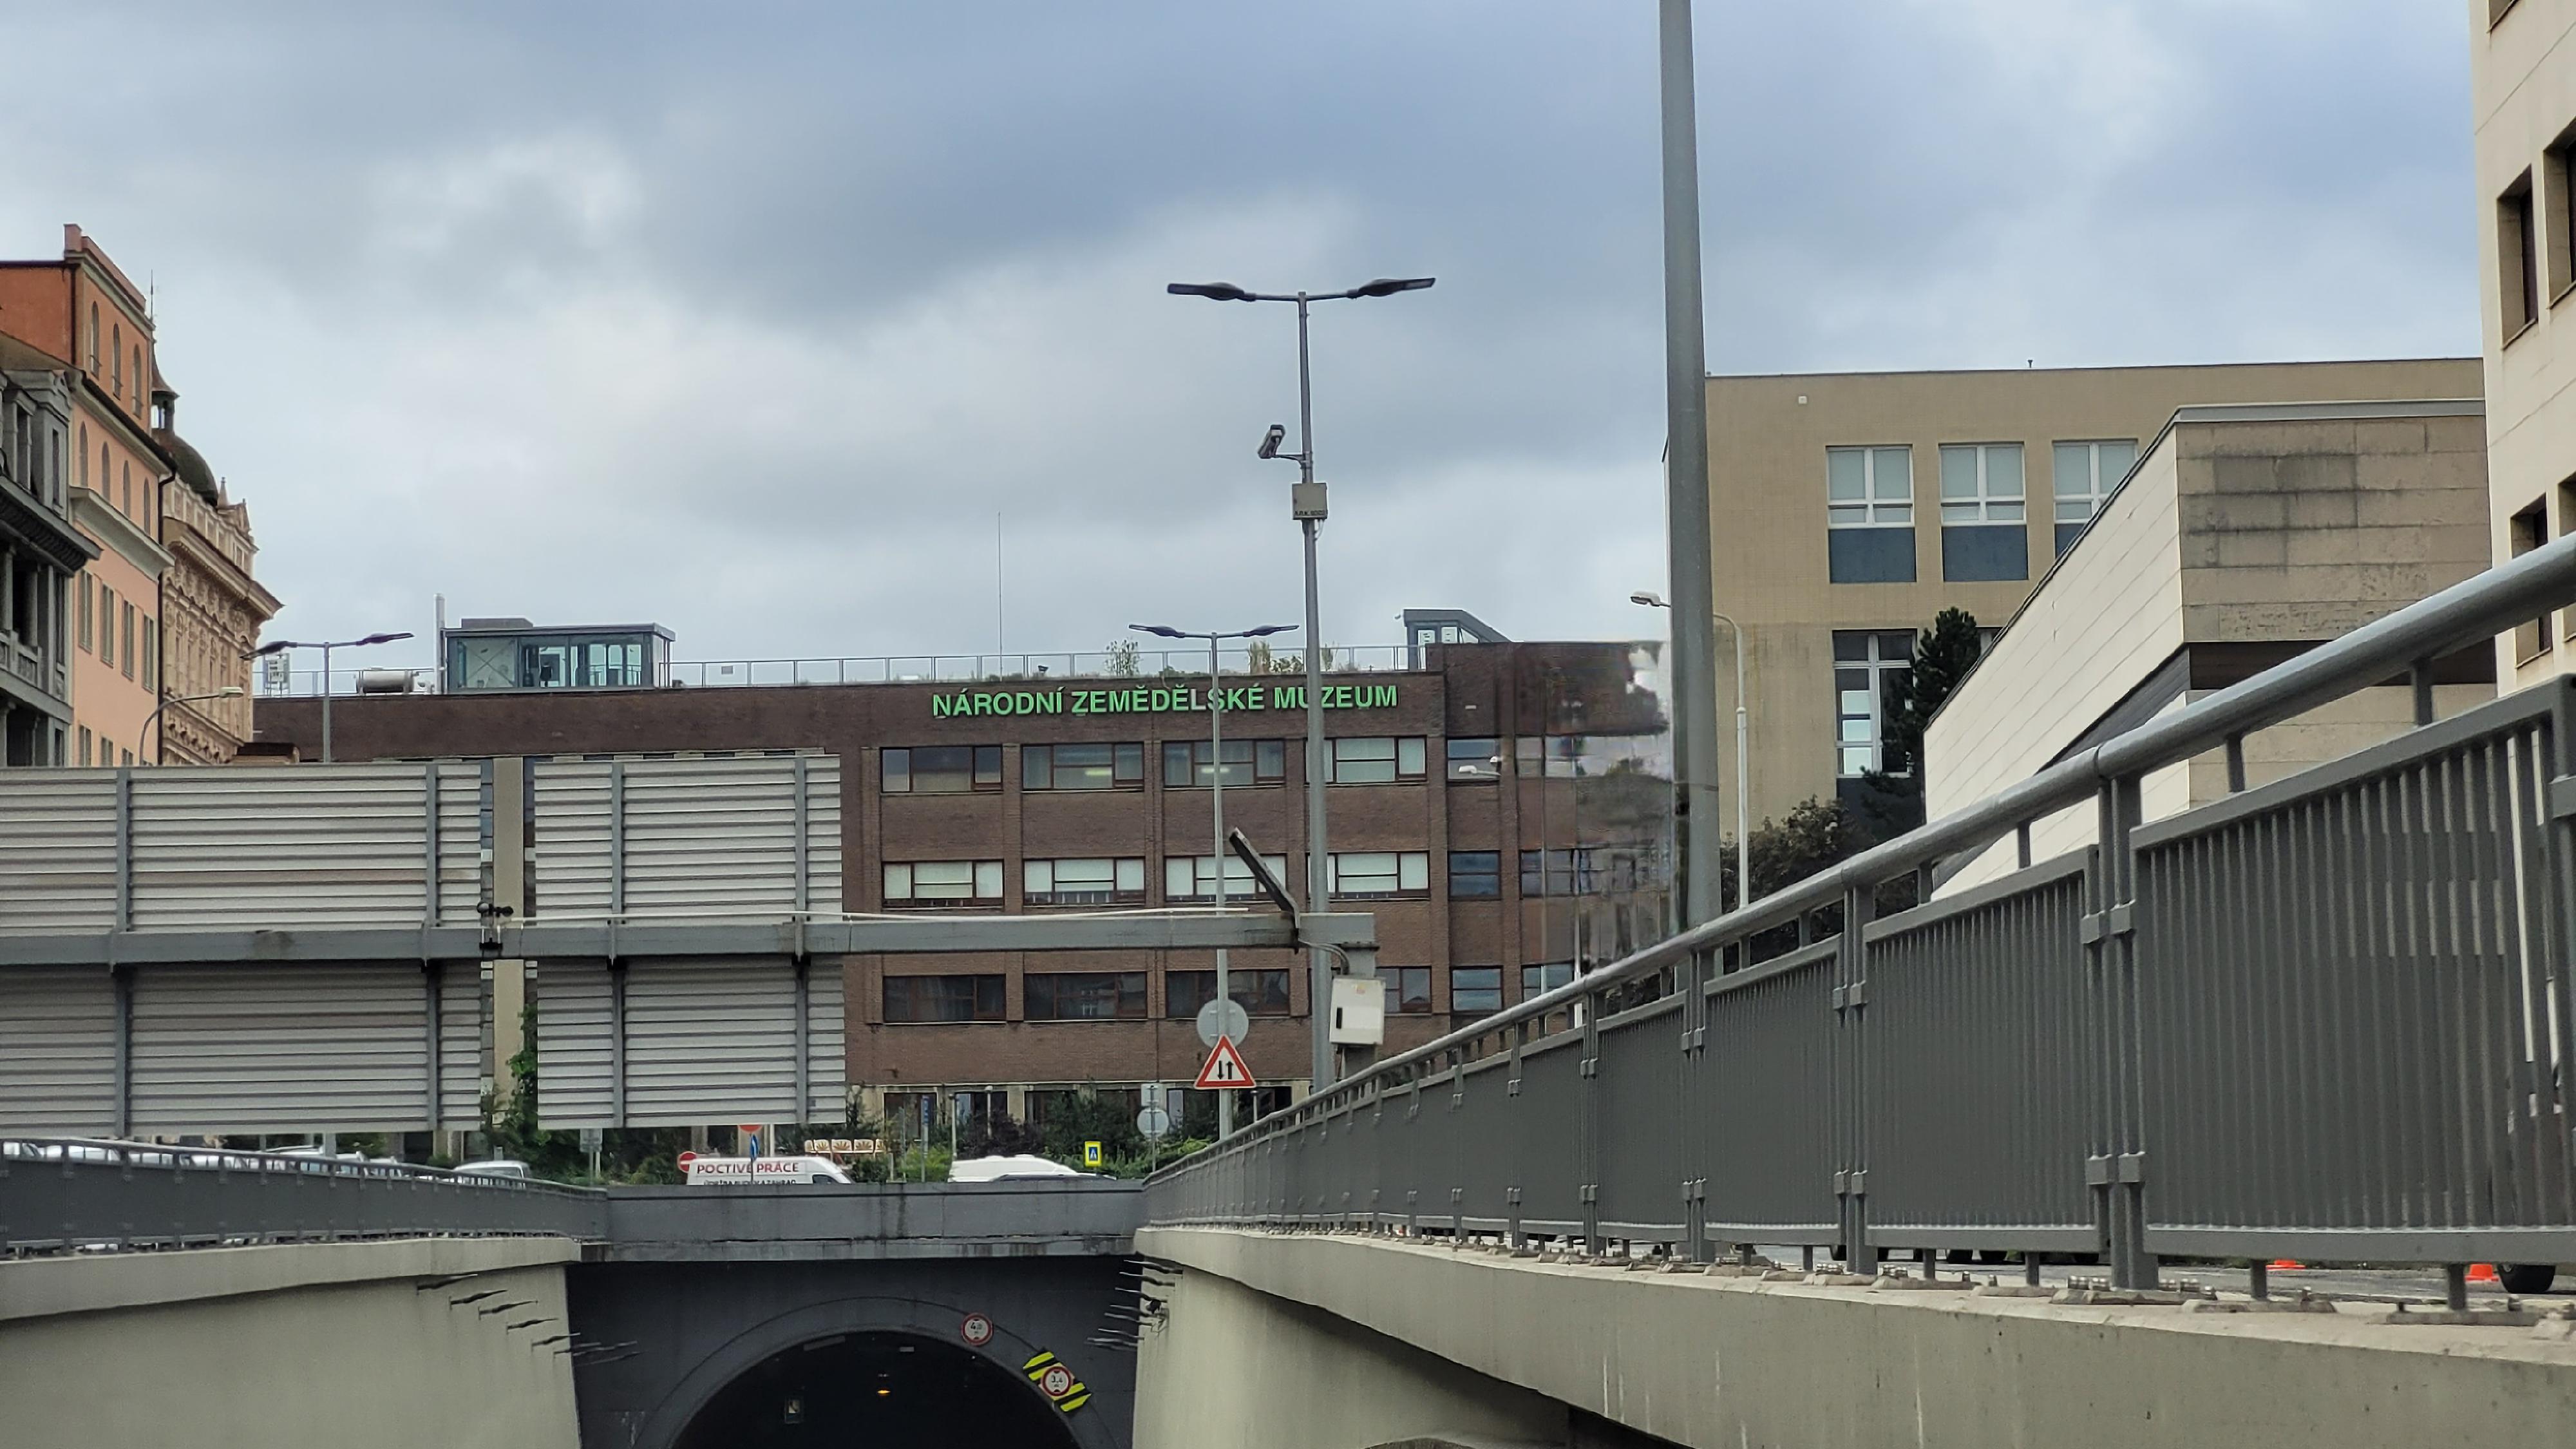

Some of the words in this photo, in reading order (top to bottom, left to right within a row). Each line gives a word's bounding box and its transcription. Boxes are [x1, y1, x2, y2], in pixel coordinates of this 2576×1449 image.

[933, 687, 1065, 716] NÁRODNÍ
[1071, 683, 1265, 713] ZEMĚDĚLSKÉ
[1274, 685, 1397, 708] MUZEUM
